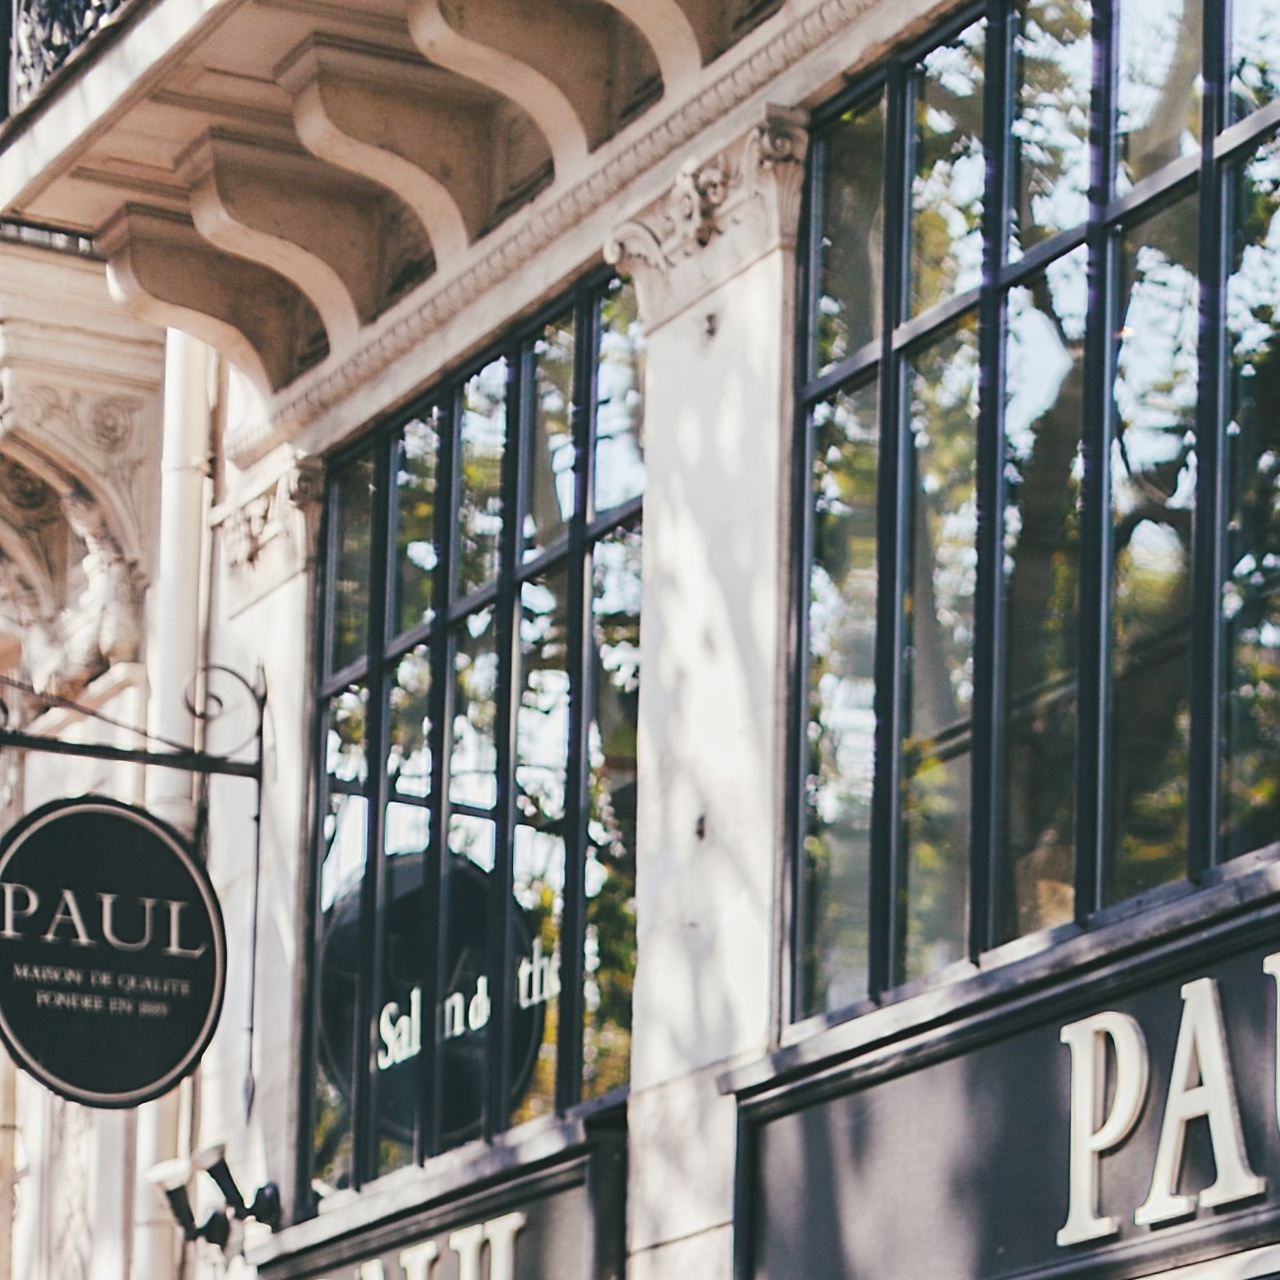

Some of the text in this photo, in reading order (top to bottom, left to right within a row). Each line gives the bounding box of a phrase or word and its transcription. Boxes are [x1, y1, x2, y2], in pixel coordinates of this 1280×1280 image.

[0, 882, 207, 959] PAUL
[13, 963, 82, 984] MAISON
[90, 969, 111, 988] DE
[109, 996, 132, 1015] EN
